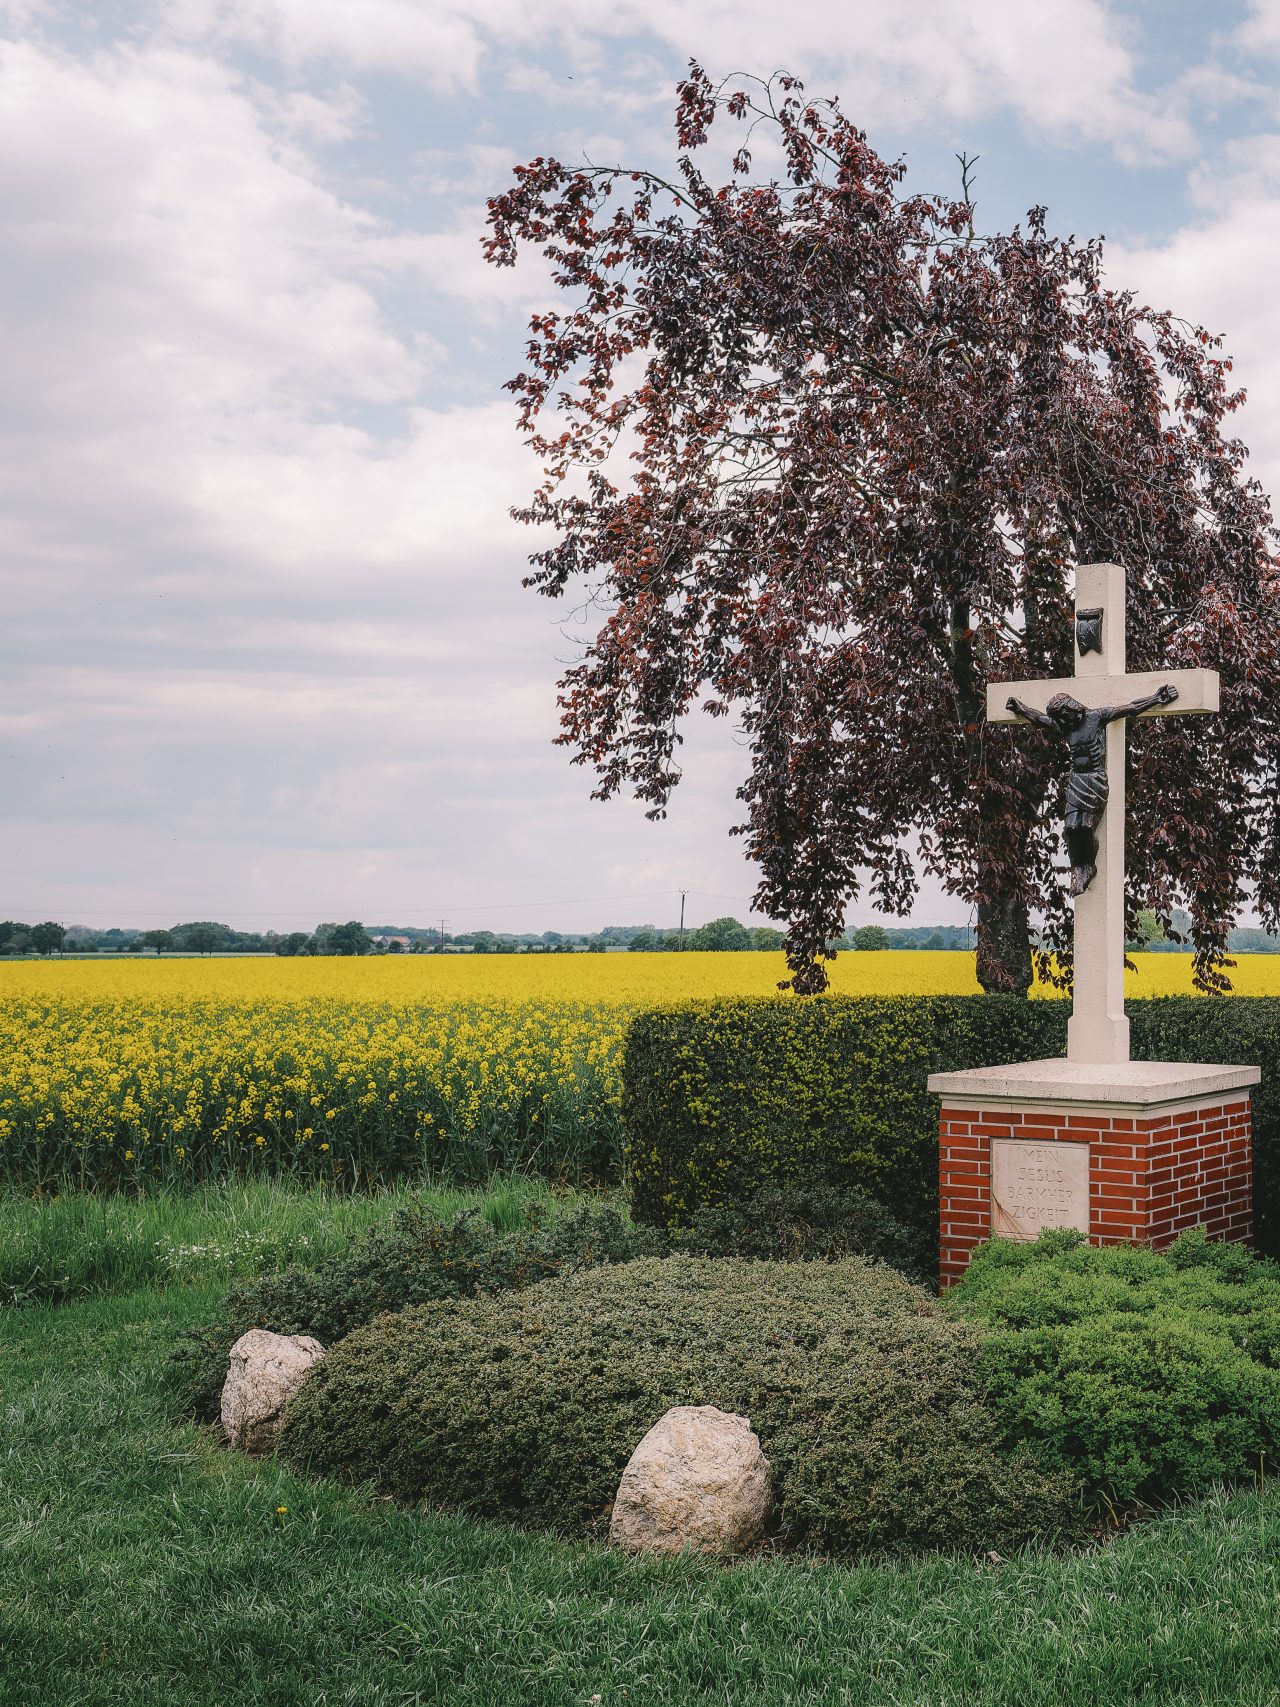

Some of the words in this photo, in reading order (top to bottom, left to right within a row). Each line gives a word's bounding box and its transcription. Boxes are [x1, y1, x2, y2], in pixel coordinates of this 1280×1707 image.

[1024, 1149, 1060, 1163] MEIN
[1018, 1167, 1064, 1183] JESUS
[1008, 1186, 1073, 1204] BARMHER
[1013, 1206, 1069, 1222] ZIGKEIT
